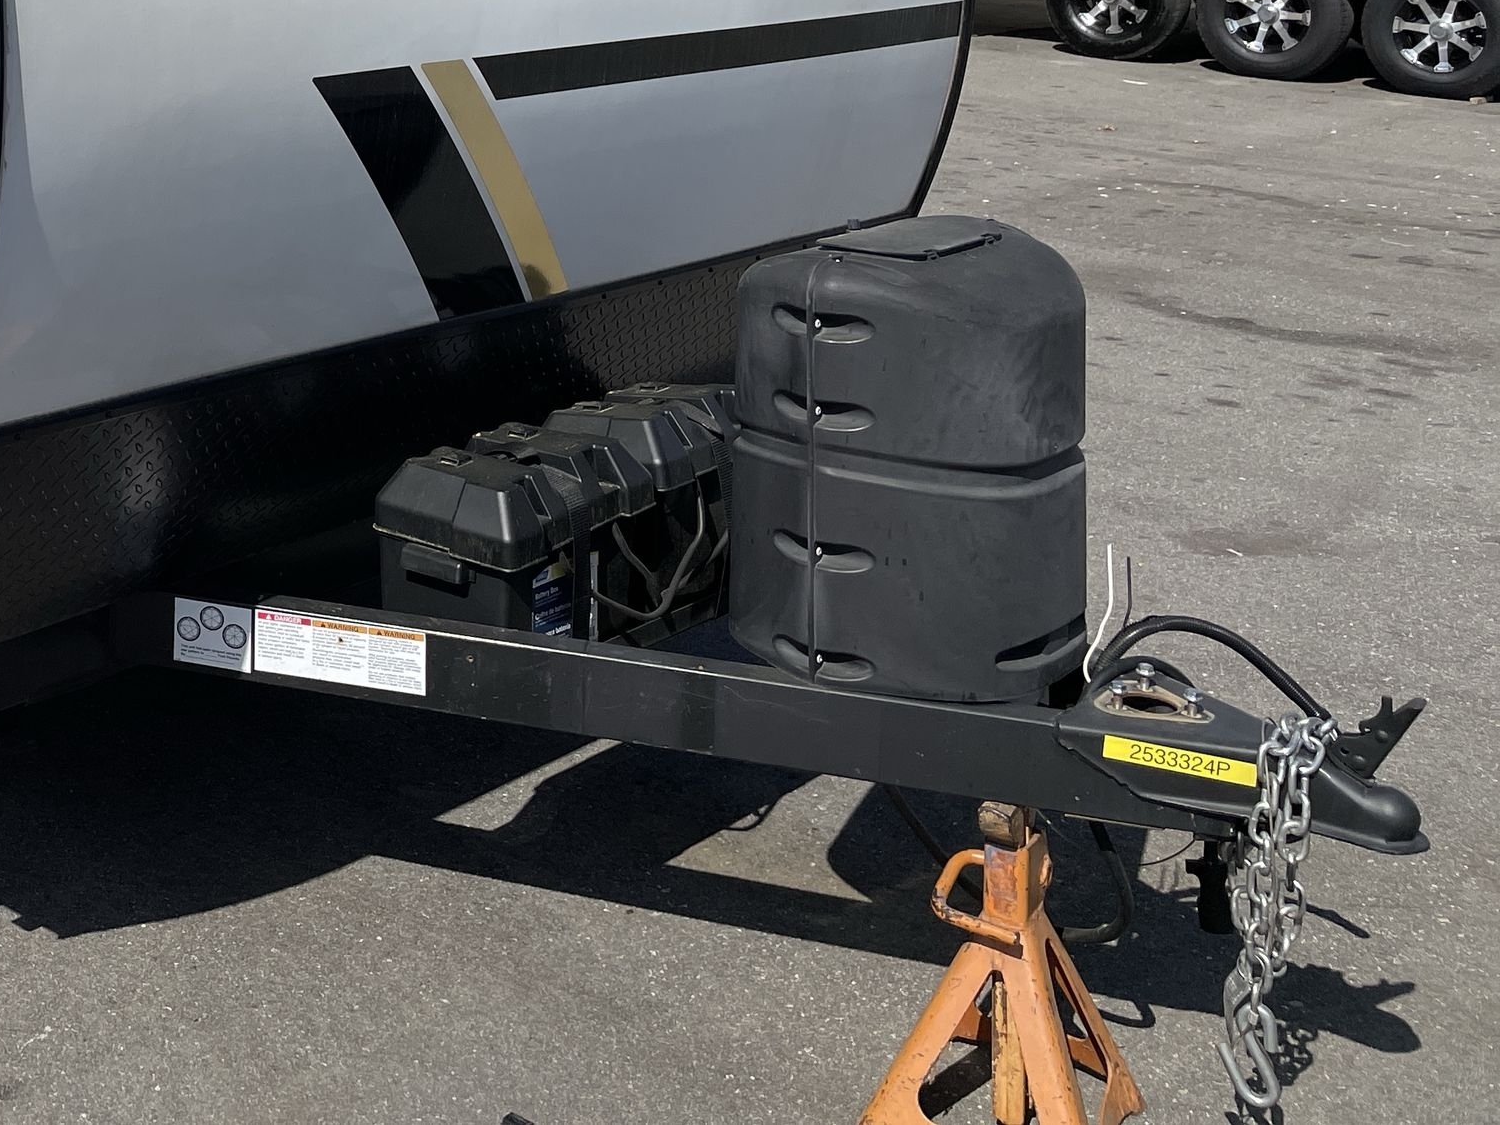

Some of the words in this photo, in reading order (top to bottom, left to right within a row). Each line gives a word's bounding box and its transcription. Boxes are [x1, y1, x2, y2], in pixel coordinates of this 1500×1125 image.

[274, 615, 302, 624] DANGER
[327, 623, 359, 633] WARNING
[383, 630, 416, 640] WARNING
[1130, 744, 1231, 776] 2533324P
